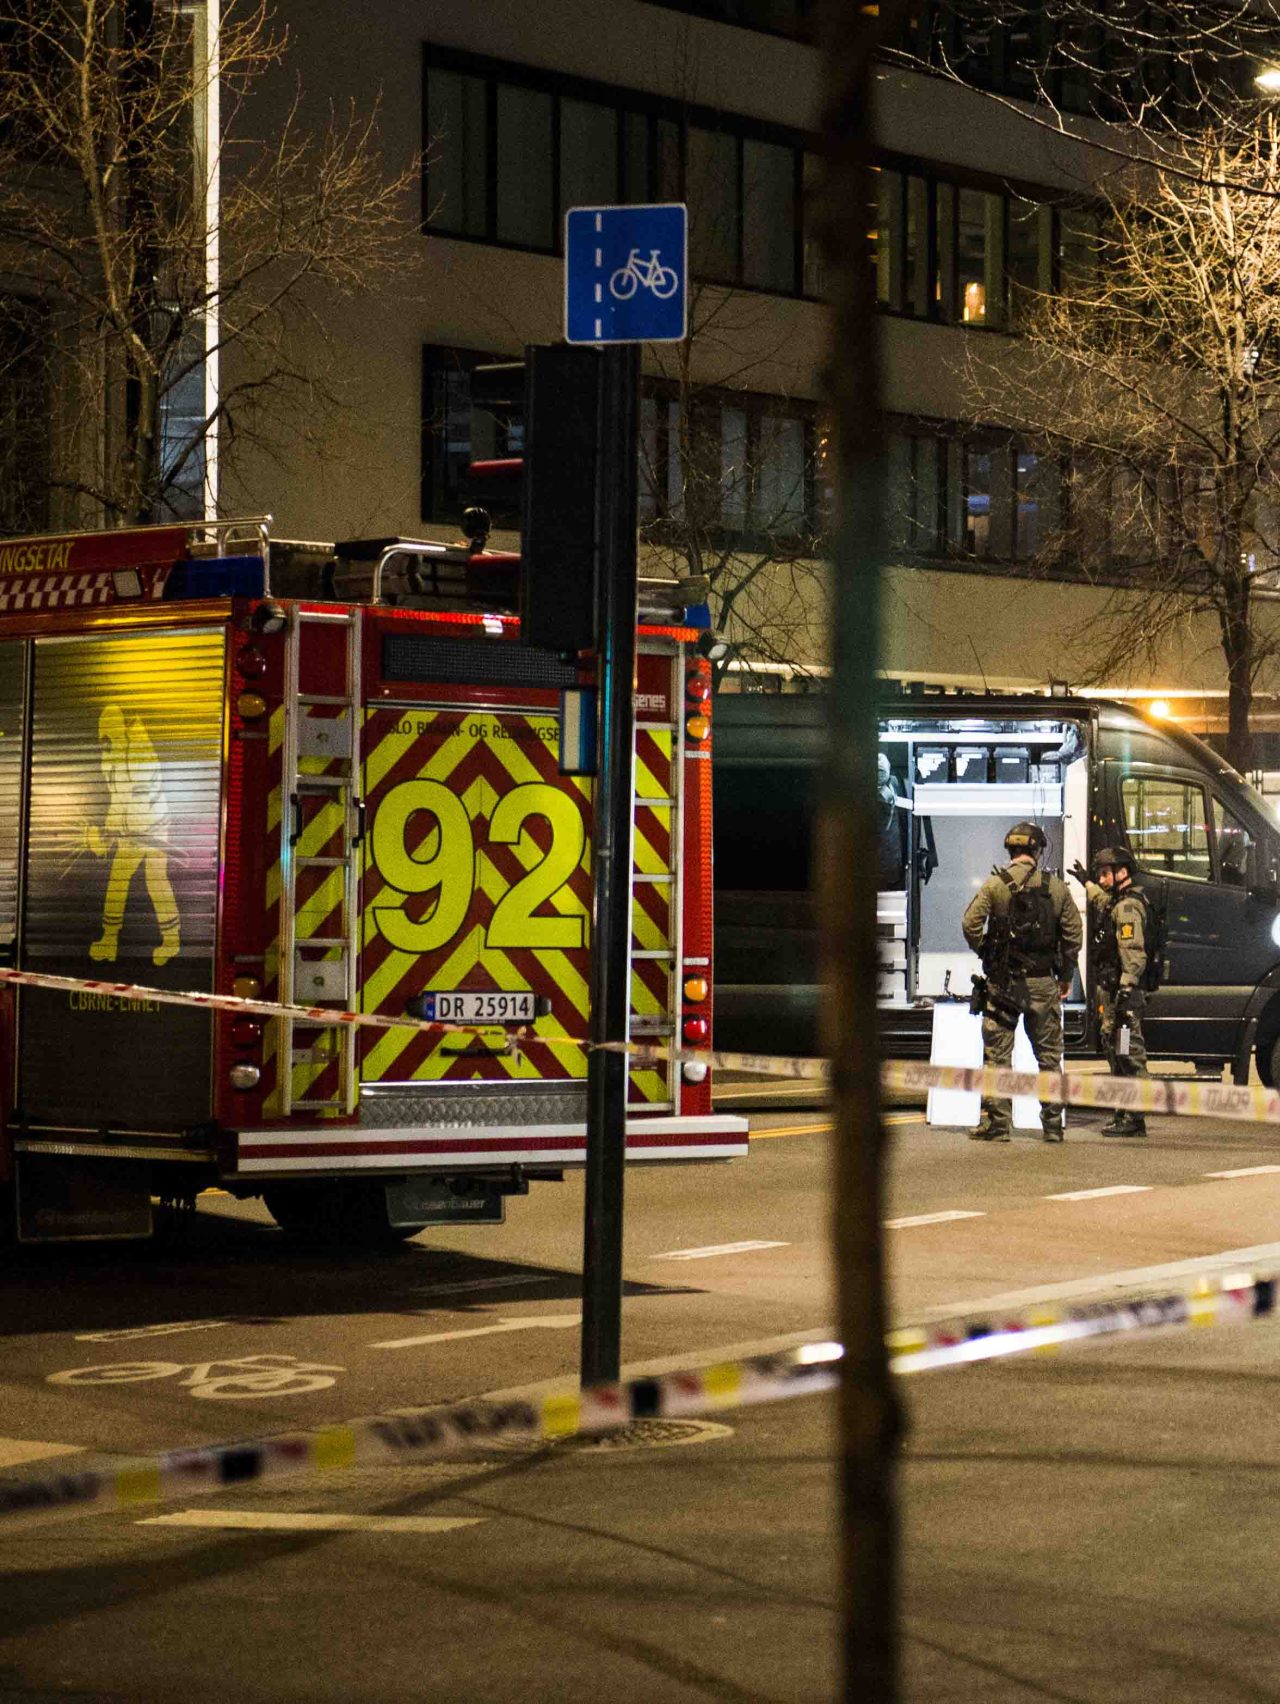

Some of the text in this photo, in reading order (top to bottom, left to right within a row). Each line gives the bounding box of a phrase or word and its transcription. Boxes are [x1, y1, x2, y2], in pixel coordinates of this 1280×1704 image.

[382, 719, 412, 735] SLO
[469, 723, 487, 738] OG
[370, 777, 586, 955] 92
[440, 996, 529, 1018] DR 25914
